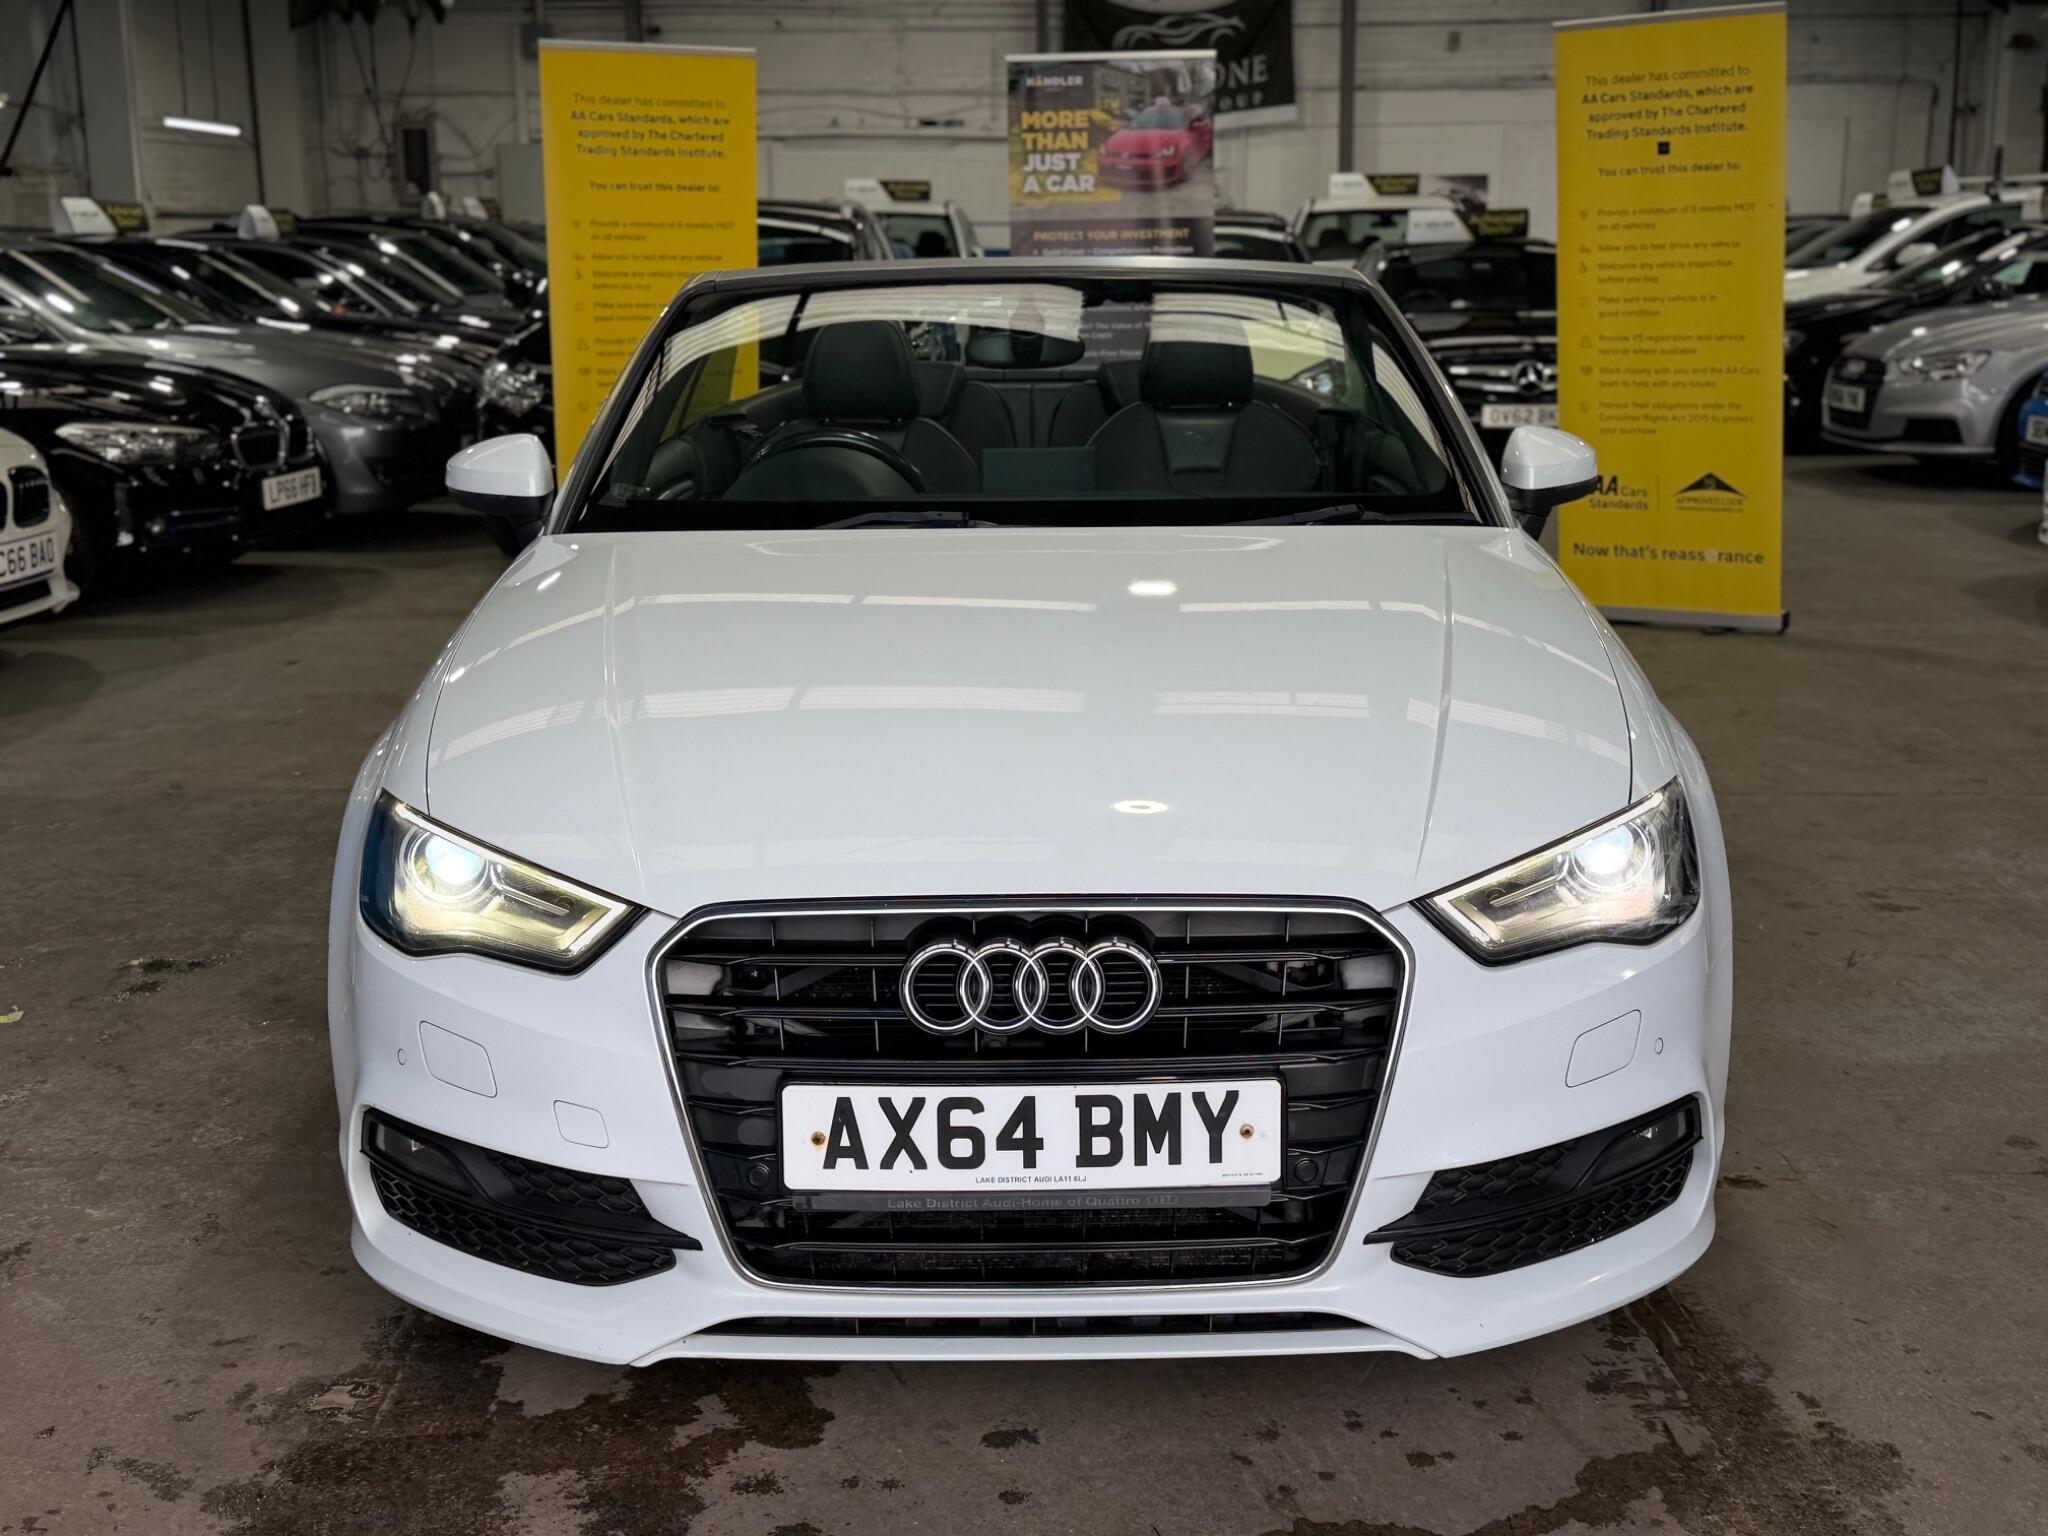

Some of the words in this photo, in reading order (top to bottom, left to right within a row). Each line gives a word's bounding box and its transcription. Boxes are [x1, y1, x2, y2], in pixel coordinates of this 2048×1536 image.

[1586, 75, 1608, 85] This
[1611, 73, 1645, 84] dealer
[1672, 66, 1734, 80] committed
[1738, 66, 1749, 75] to
[1582, 94, 1597, 104] AA
[1602, 93, 1626, 103] Cars
[1696, 85, 1731, 96] which
[1735, 85, 1753, 94] are
[1021, 111, 1089, 129] MORE
[1589, 109, 1641, 123] approved
[1646, 109, 1658, 119] by
[1662, 107, 1682, 116] The
[1687, 103, 1746, 115] Chartered
[1022, 131, 1088, 150] THAN
[1587, 129, 1629, 140] Trading
[1632, 125, 1691, 137] Standards
[1023, 153, 1081, 171] JUST
[1023, 175, 1040, 194] A
[1045, 174, 1095, 192] CAR
[1033, 230, 1084, 241] PROTECT
[1088, 230, 1118, 240] YOUR
[1120, 228, 1190, 239] INVESTMENT
[1594, 475, 1618, 496] AA
[1621, 486, 1648, 497] Cars
[1589, 499, 1649, 510] Standards
[1573, 543, 1608, 556] Now
[822, 1096, 1044, 1171] AX64
[1075, 1089, 1239, 1168] BMY
[976, 1176, 996, 1184] LAKE
[997, 1176, 1032, 1184] DISTRICT
[1034, 1175, 1053, 1183] AUDI
[888, 1198, 922, 1209] Lake
[926, 1198, 978, 1209] District
[1068, 1197, 1082, 1207] of
[1086, 1196, 1141, 1207] Quattro
